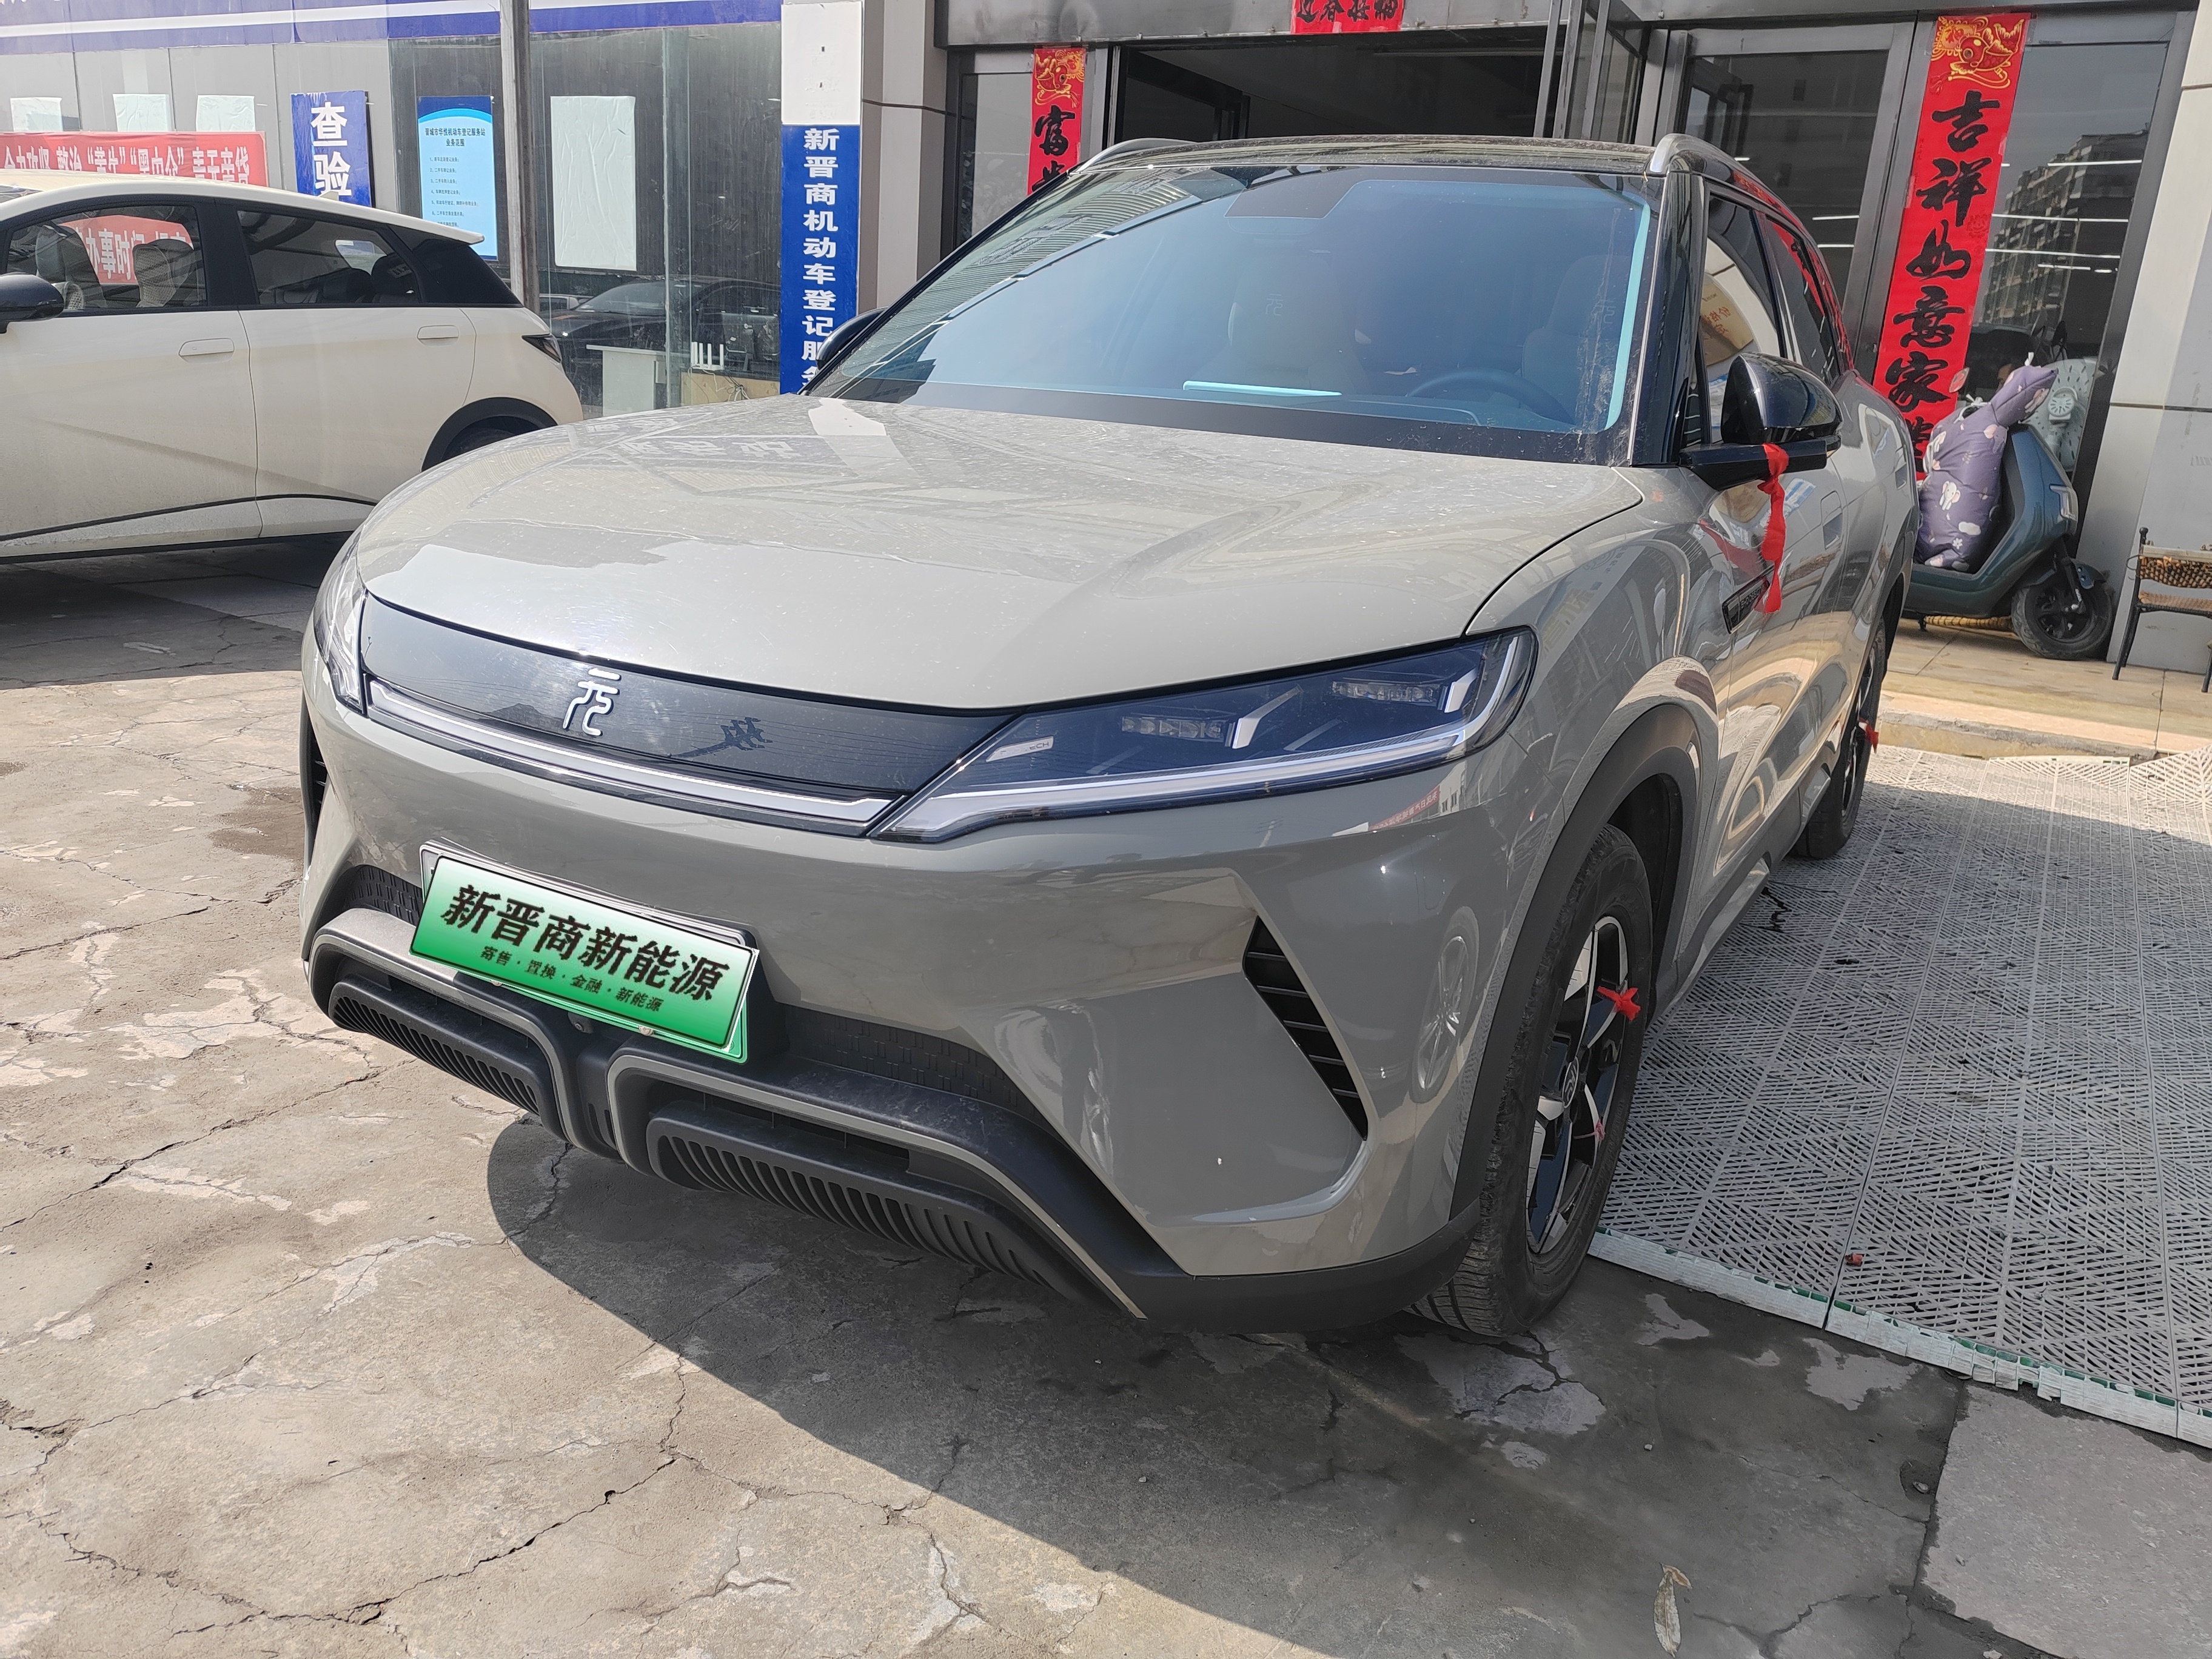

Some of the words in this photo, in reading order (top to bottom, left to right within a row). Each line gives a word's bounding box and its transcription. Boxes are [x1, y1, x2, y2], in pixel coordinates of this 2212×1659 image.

[310, 102, 352, 196] 查验
[75, 227, 146, 280] 办事时
